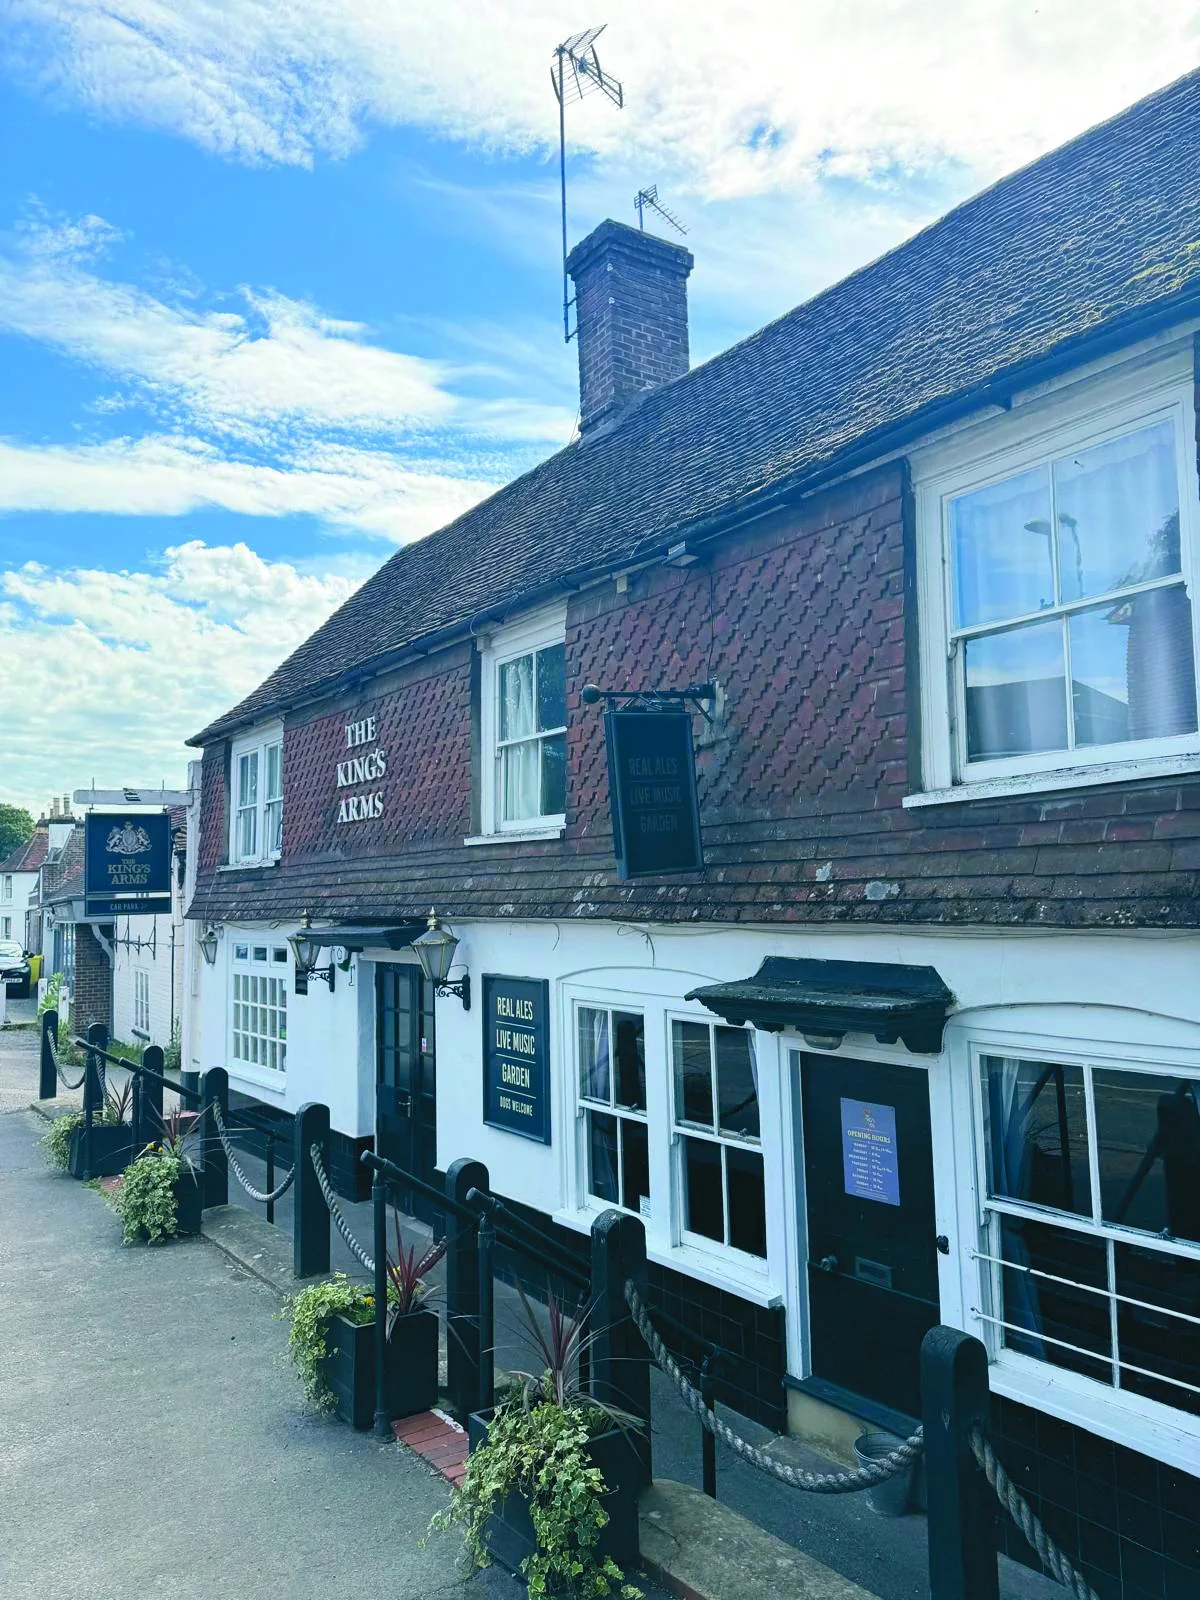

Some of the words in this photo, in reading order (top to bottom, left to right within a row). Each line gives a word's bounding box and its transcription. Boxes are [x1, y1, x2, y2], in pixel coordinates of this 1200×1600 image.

[345, 716, 377, 749] THE
[337, 748, 386, 788] KING'S
[628, 757, 653, 776] REAL
[655, 757, 678, 775] ALES
[630, 786, 651, 806] LIVE
[653, 785, 682, 804] MUSIC
[337, 791, 384, 823] ARMS
[640, 814, 678, 833] GARDEN
[107, 864, 151, 874] KING'S
[111, 874, 148, 884] ARMS
[110, 903, 122, 911] CAR
[496, 996, 515, 1018] REAL
[516, 999, 533, 1021] ALES
[496, 1028, 512, 1050] LIVE
[512, 1031, 536, 1055] MUSIC
[502, 1063, 530, 1088] GARDEN
[499, 1095, 511, 1110] DOGS
[511, 1099, 533, 1117] WELCOME
[847, 1129, 872, 1140] OPENING
